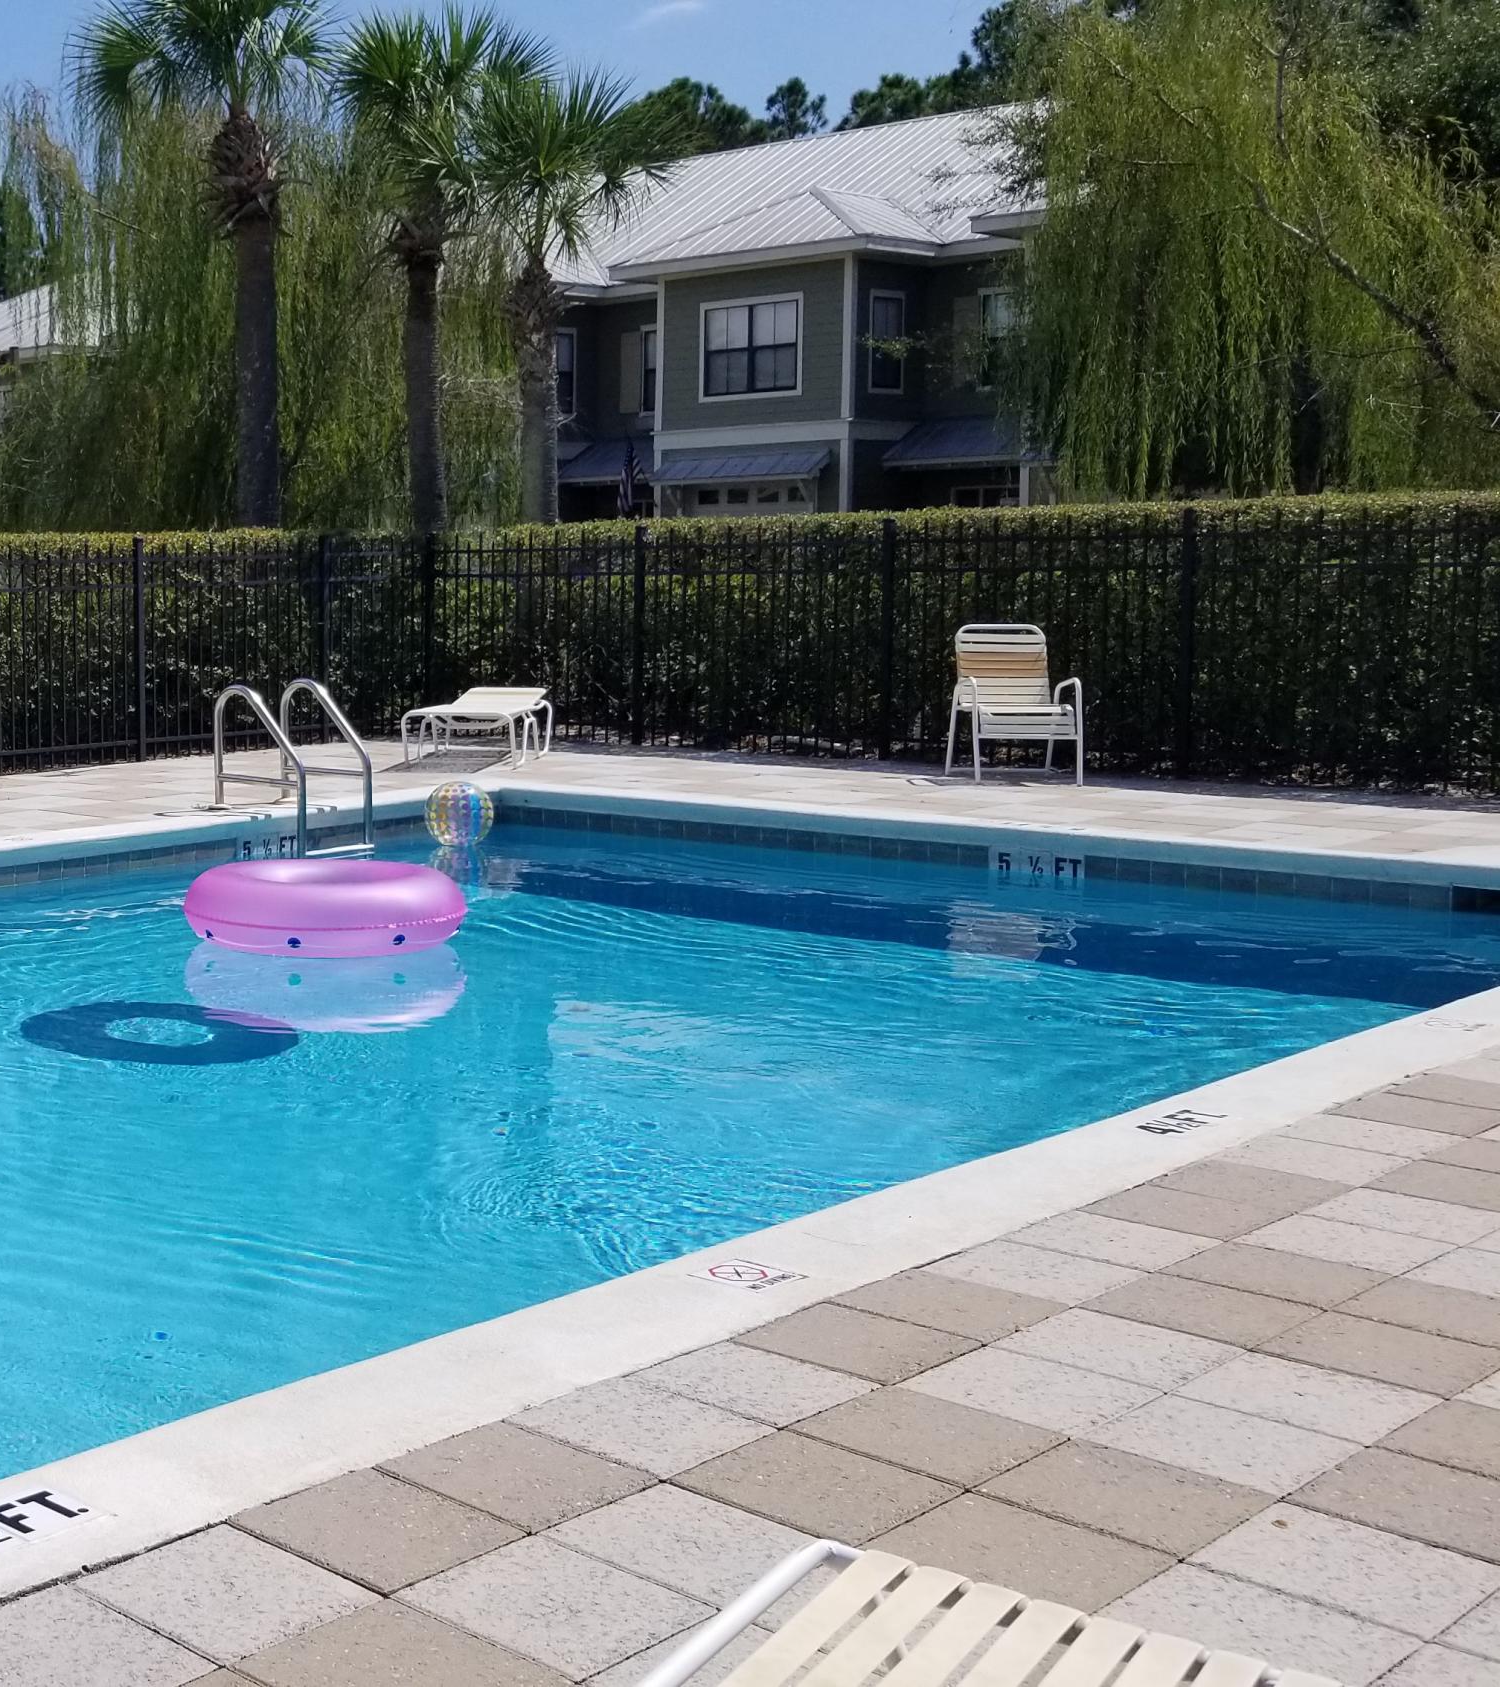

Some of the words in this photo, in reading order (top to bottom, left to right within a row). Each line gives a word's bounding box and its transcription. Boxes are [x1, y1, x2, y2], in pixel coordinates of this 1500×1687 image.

[242, 840, 252, 856] 5
[279, 834, 298, 853] FT
[998, 852, 1012, 872] 5
[1054, 857, 1083, 878] FT
